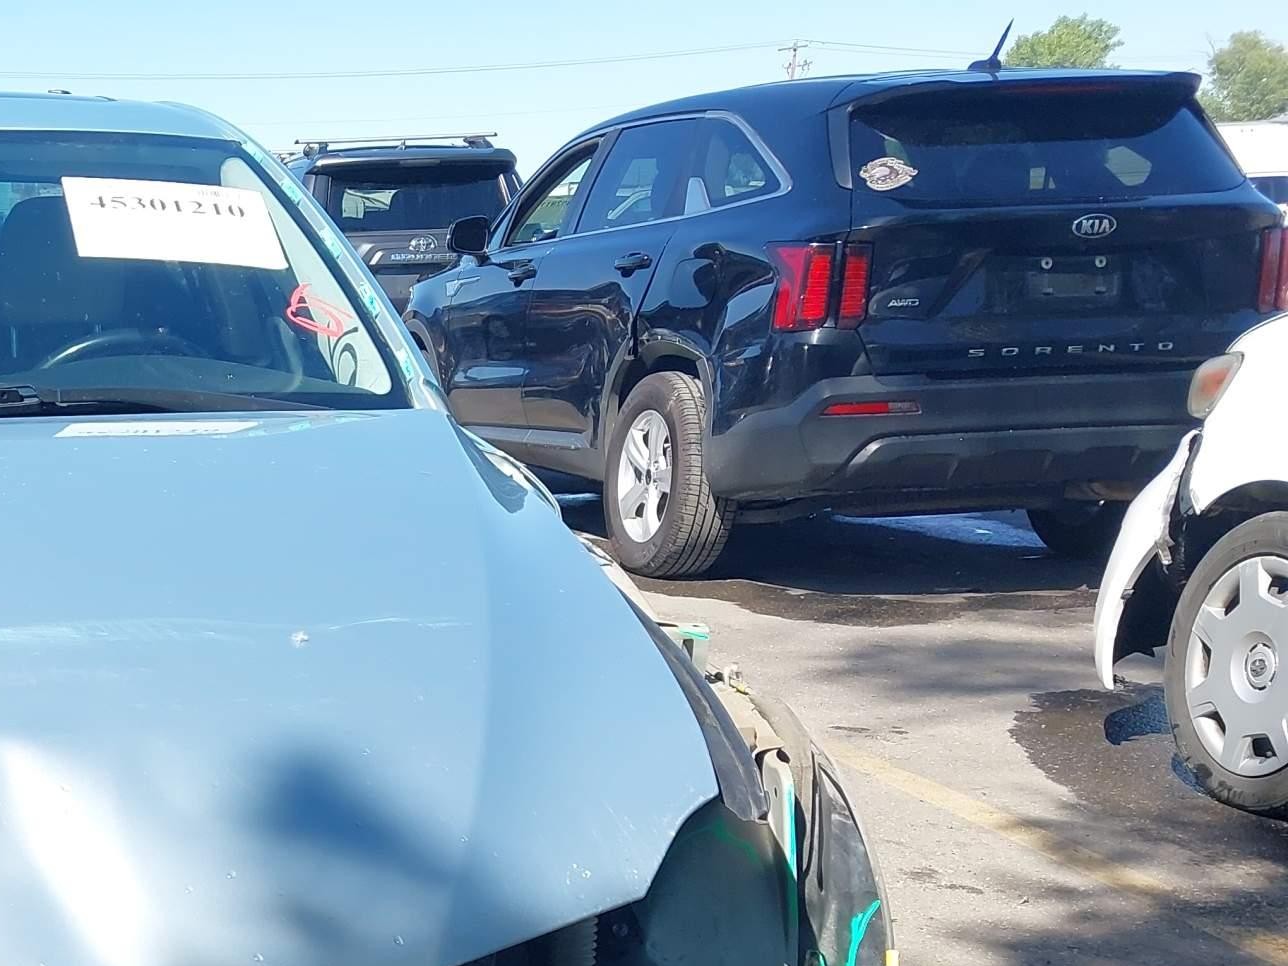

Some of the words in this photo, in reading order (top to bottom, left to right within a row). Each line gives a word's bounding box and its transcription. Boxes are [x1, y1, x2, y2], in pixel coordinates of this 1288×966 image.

[89, 195, 246, 218] 45301210
[1080, 218, 1110, 234] KIA
[887, 298, 920, 308] AWD
[967, 341, 1174, 358] SORENTO
